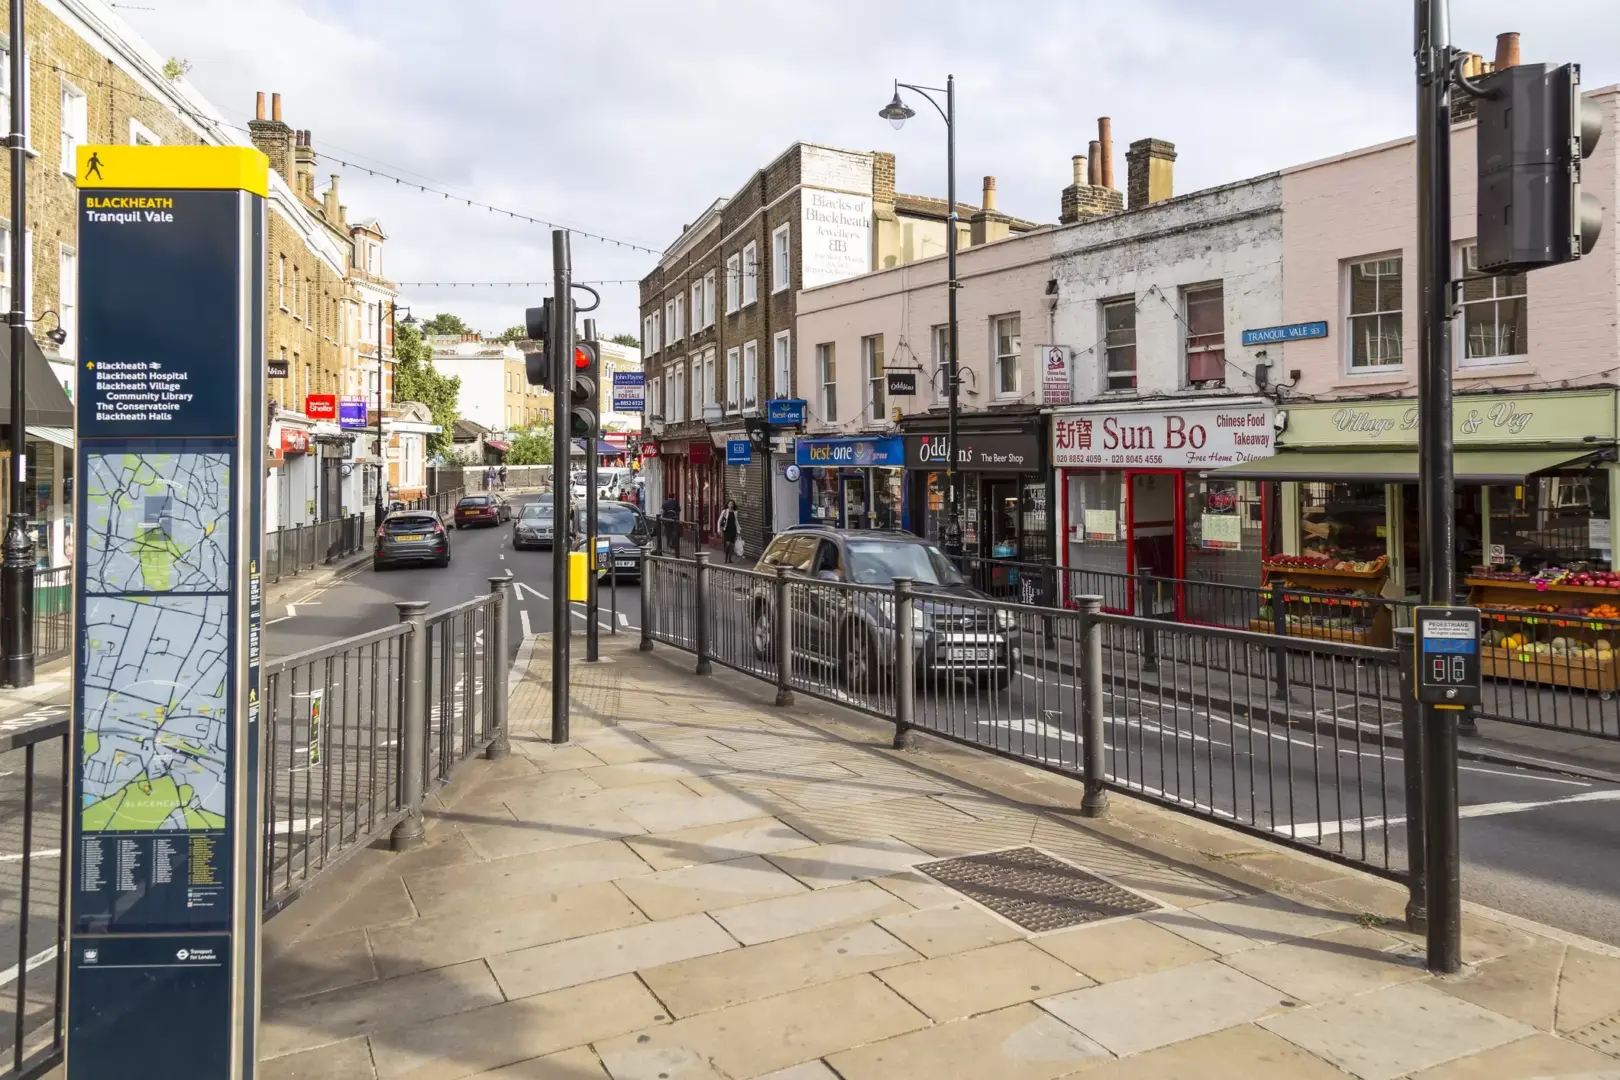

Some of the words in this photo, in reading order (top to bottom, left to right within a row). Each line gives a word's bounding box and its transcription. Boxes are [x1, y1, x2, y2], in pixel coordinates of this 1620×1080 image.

[86, 197, 173, 209] BLACKHEATH
[812, 193, 851, 211] Blacks
[854, 201, 865, 213] of
[86, 210, 142, 224] Tranquil
[144, 211, 174, 222] Vale
[806, 207, 870, 228] Blackheath
[816, 226, 860, 239] Jewellers
[1248, 330, 1286, 342] TRANQUIL
[1289, 326, 1308, 337] VALE
[96, 362, 147, 370] Blackheath
[96, 372, 147, 380] Blackheath
[149, 372, 188, 381] Hospital
[96, 382, 147, 390] Blackheath
[149, 382, 181, 391] Village
[106, 392, 159, 401] Community
[161, 392, 193, 402] Library
[96, 402, 114, 410] The
[116, 402, 180, 410] Conservatoire
[96, 412, 147, 420] Blackheath
[149, 412, 172, 420] Halls
[772, 411, 800, 419] best-one
[1216, 414, 1245, 427] Chinese
[1247, 413, 1265, 427] Food
[1332, 408, 1394, 437] Village
[1461, 409, 1483, 434] &
[1487, 401, 1534, 434] Veg
[1056, 418, 1092, 450] 新寶
[1103, 416, 1155, 450] Sun
[1163, 415, 1206, 449] Bo
[1233, 432, 1270, 448] Takeaway
[644, 445, 657, 456] illy
[810, 444, 853, 461] best-one
[920, 437, 973, 462] Oddns
[981, 453, 992, 462] The
[993, 453, 1007, 462] Beer
[1008, 453, 1024, 464] Shop
[1056, 454, 1067, 463] 020
[1069, 454, 1084, 463] 8852
[1086, 454, 1101, 463] 4059
[1111, 455, 1124, 464] 020
[1125, 455, 1143, 464] 8045
[1145, 455, 1163, 464] 4556
[1185, 451, 1206, 464] Free
[1208, 451, 1232, 462] Home
[1235, 451, 1267, 462] Delive
